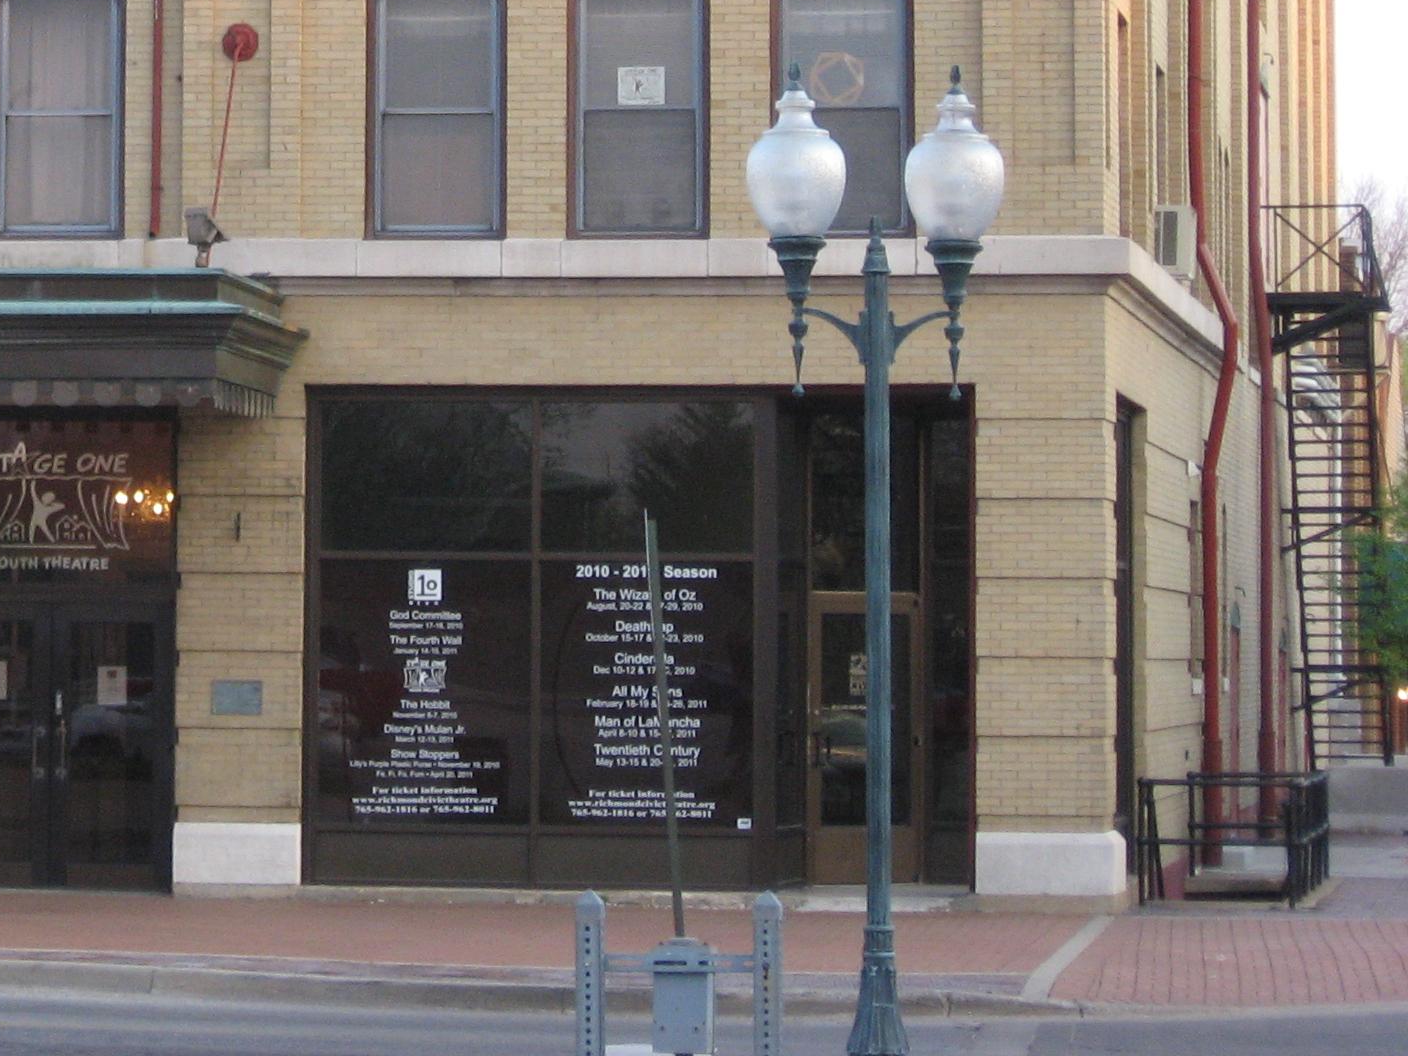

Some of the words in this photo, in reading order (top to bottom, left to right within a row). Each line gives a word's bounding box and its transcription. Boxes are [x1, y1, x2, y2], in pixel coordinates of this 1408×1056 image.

[76, 452, 130, 474] ONE
[44, 555, 109, 570] THEATRE
[575, 565, 610, 578] 2010
[623, 565, 649, 578] 201
[663, 565, 717, 578] Season
[593, 588, 616, 600] The
[664, 588, 676, 600] of
[679, 588, 697, 600] Oz
[682, 602, 704, 611] 2010
[411, 611, 462, 620] Committee
[389, 635, 408, 645] The
[410, 635, 440, 645] Fourth
[442, 635, 462, 645] Wall
[585, 633, 619, 643] October
[621, 633, 643, 643] 15-17
[682, 633, 704, 643] 2010
[593, 666, 610, 675] Dec
[612, 666, 635, 675] 10-12
[674, 666, 696, 675] 2010
[612, 685, 627, 698] All
[630, 685, 649, 698] My
[652, 685, 683, 698] Sns
[400, 700, 418, 709] The
[420, 700, 451, 709] Hobbit
[586, 699, 623, 708] February
[687, 699, 708, 708] 2011
[594, 716, 620, 727] Man
[624, 716, 636, 727] of
[383, 724, 423, 735] Disney's
[425, 724, 453, 735] Mulan
[455, 724, 467, 735] Jr.
[598, 729, 617, 738] April
[677, 729, 697, 738] 2011
[391, 749, 417, 760] Show
[419, 749, 460, 760] Stoppers
[594, 744, 650, 757] Twentieth
[654, 744, 701, 757] Cntury
[595, 758, 613, 767] May
[678, 758, 698, 767] 2011
[588, 790, 606, 798] For
[608, 790, 635, 798] ticket
[351, 796, 499, 805] www.richmondcivictheatre.org
[420, 806, 430, 814] or
[636, 809, 647, 818] or
